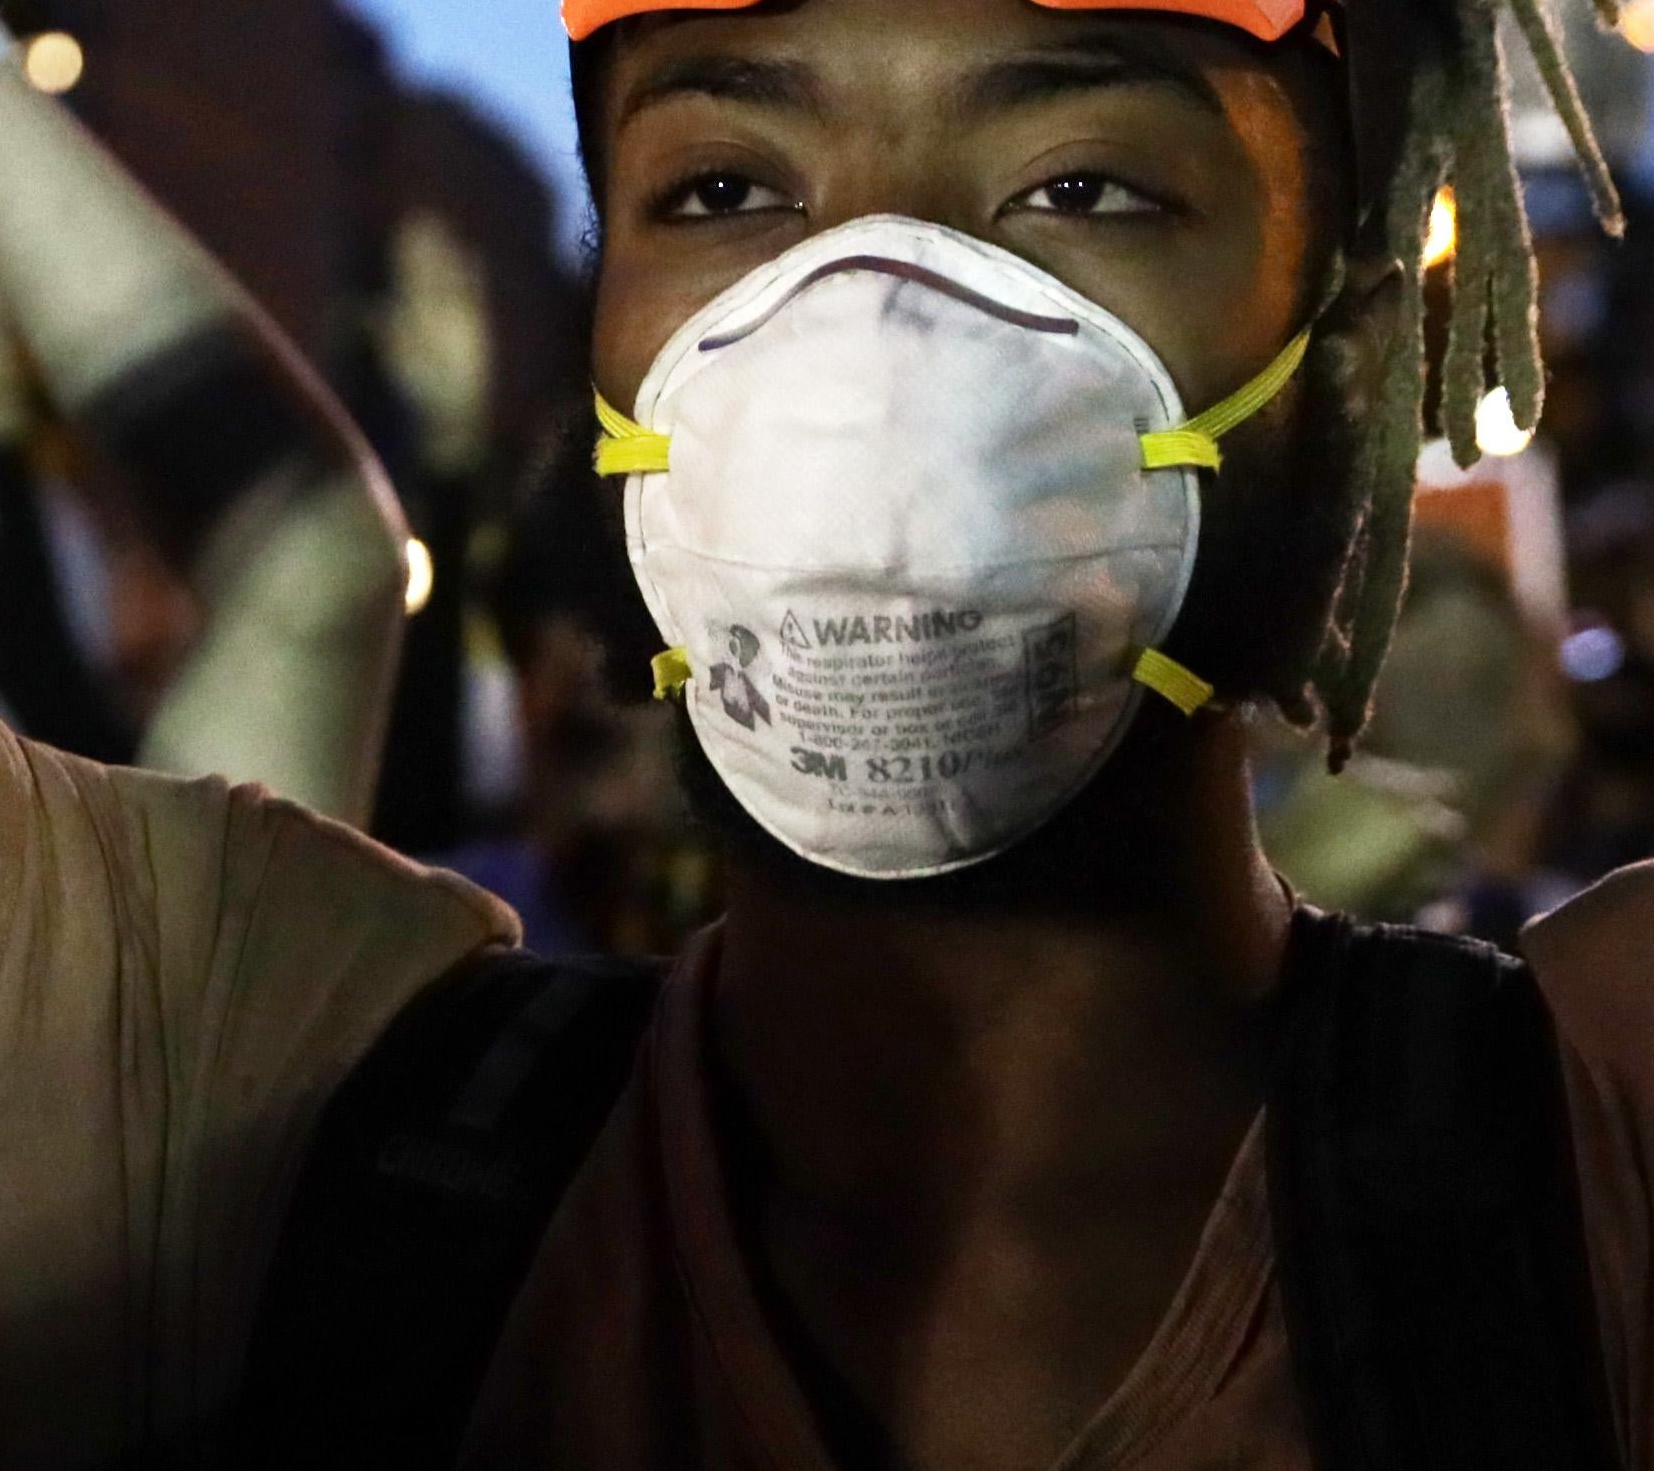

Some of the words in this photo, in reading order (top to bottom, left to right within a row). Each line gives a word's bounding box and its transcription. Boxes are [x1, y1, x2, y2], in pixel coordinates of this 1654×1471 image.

[812, 609, 983, 647] WARNING
[806, 654, 893, 671] respirator
[788, 666, 847, 686] against
[851, 670, 915, 687] certain
[772, 673, 823, 700] Misuse
[827, 693, 865, 708] may
[871, 686, 922, 702] result
[850, 707, 879, 720] For
[886, 702, 946, 721] proper
[779, 712, 865, 735] supervisor
[870, 725, 889, 736] or
[789, 746, 848, 782] 3M
